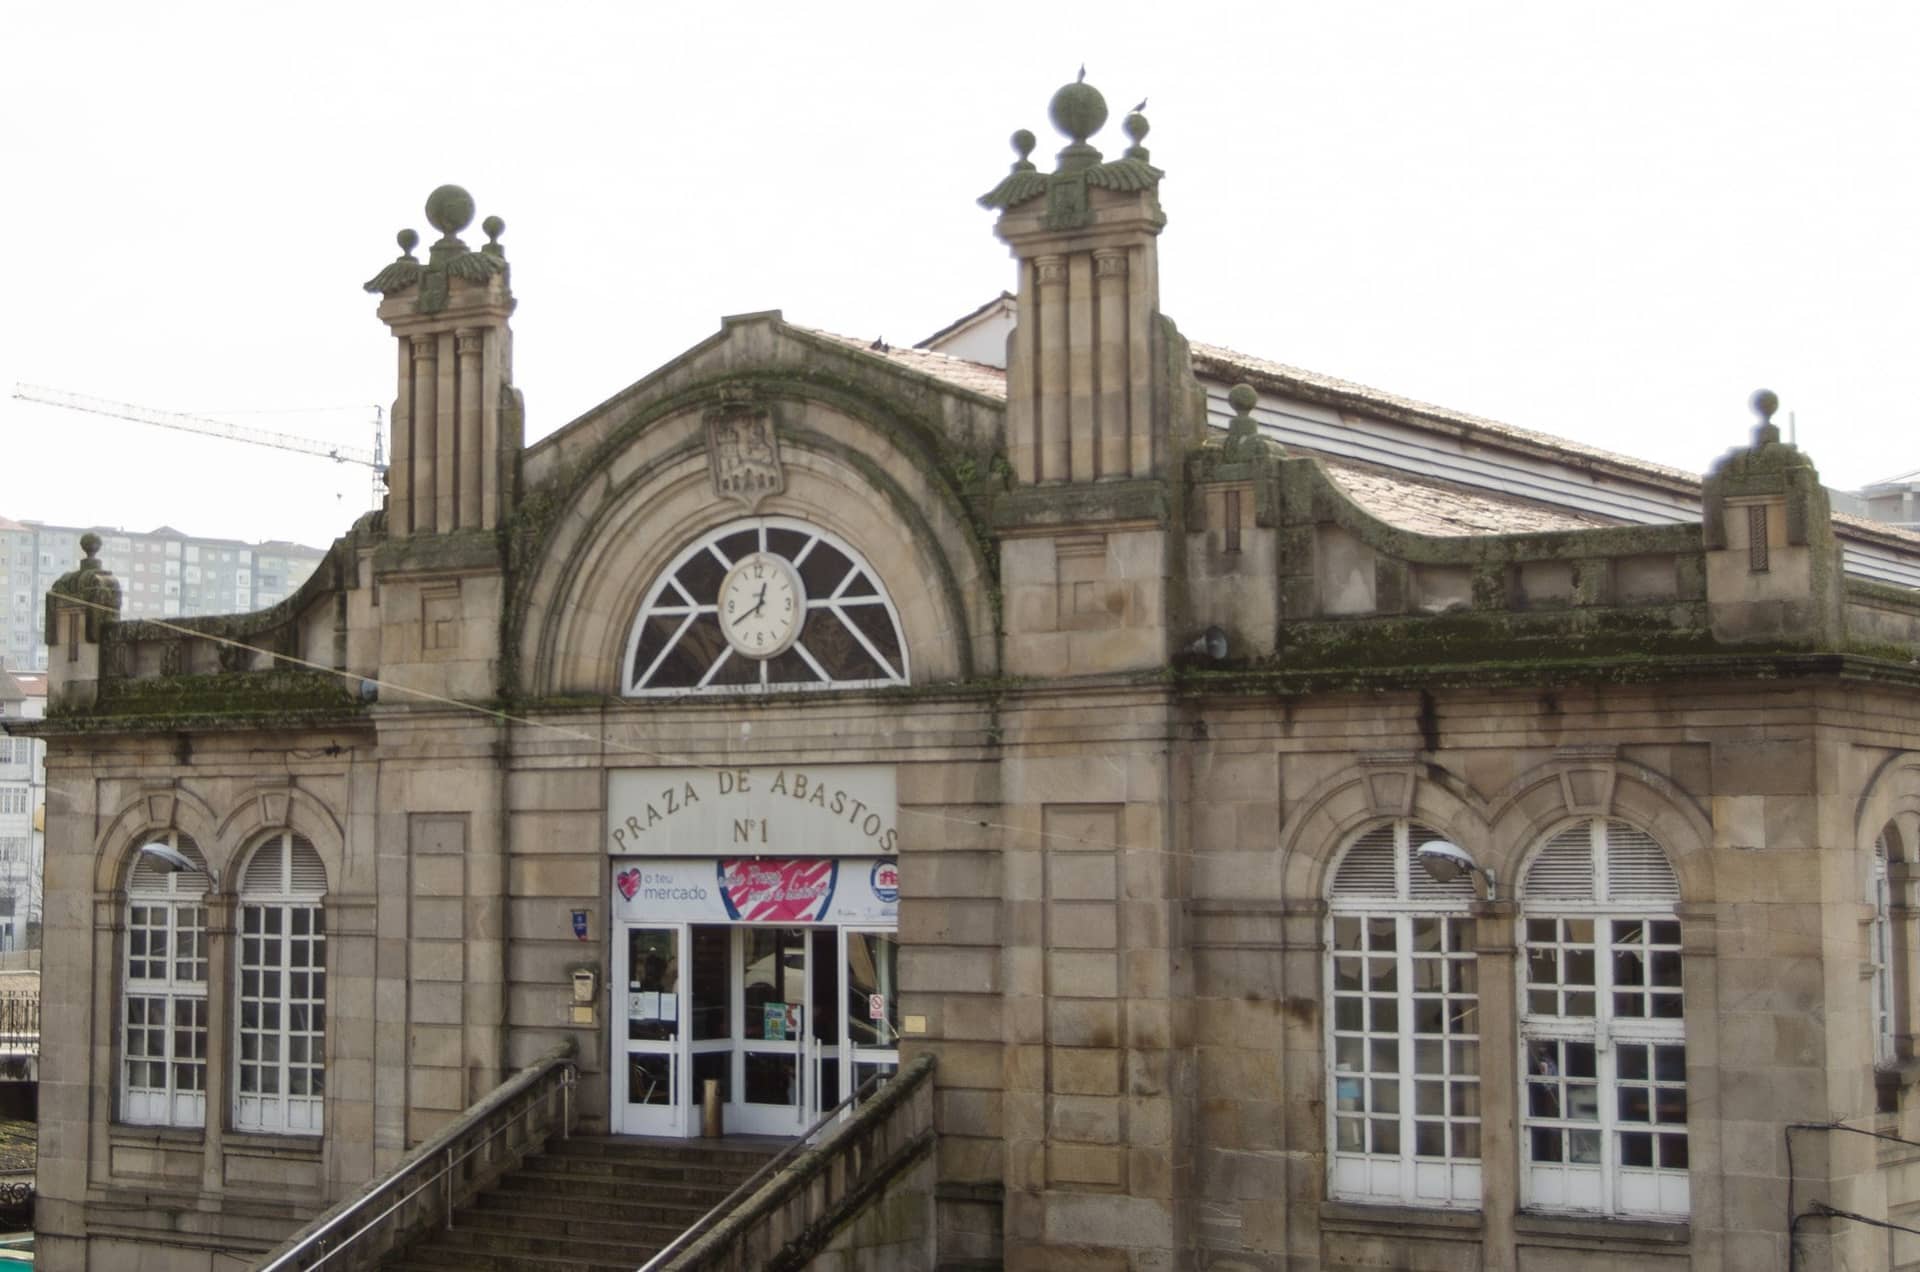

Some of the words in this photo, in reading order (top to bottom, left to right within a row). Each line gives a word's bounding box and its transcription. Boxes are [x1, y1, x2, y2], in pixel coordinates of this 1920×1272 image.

[753, 565, 764, 579] 12
[728, 600, 735, 614] 9
[784, 598, 791, 611] 3
[611, 780, 699, 851] PRAZA
[718, 768, 751, 795] DE
[770, 769, 898, 852] ABASTOS
[644, 874, 652, 884] o
[644, 886, 707, 900] mercado
